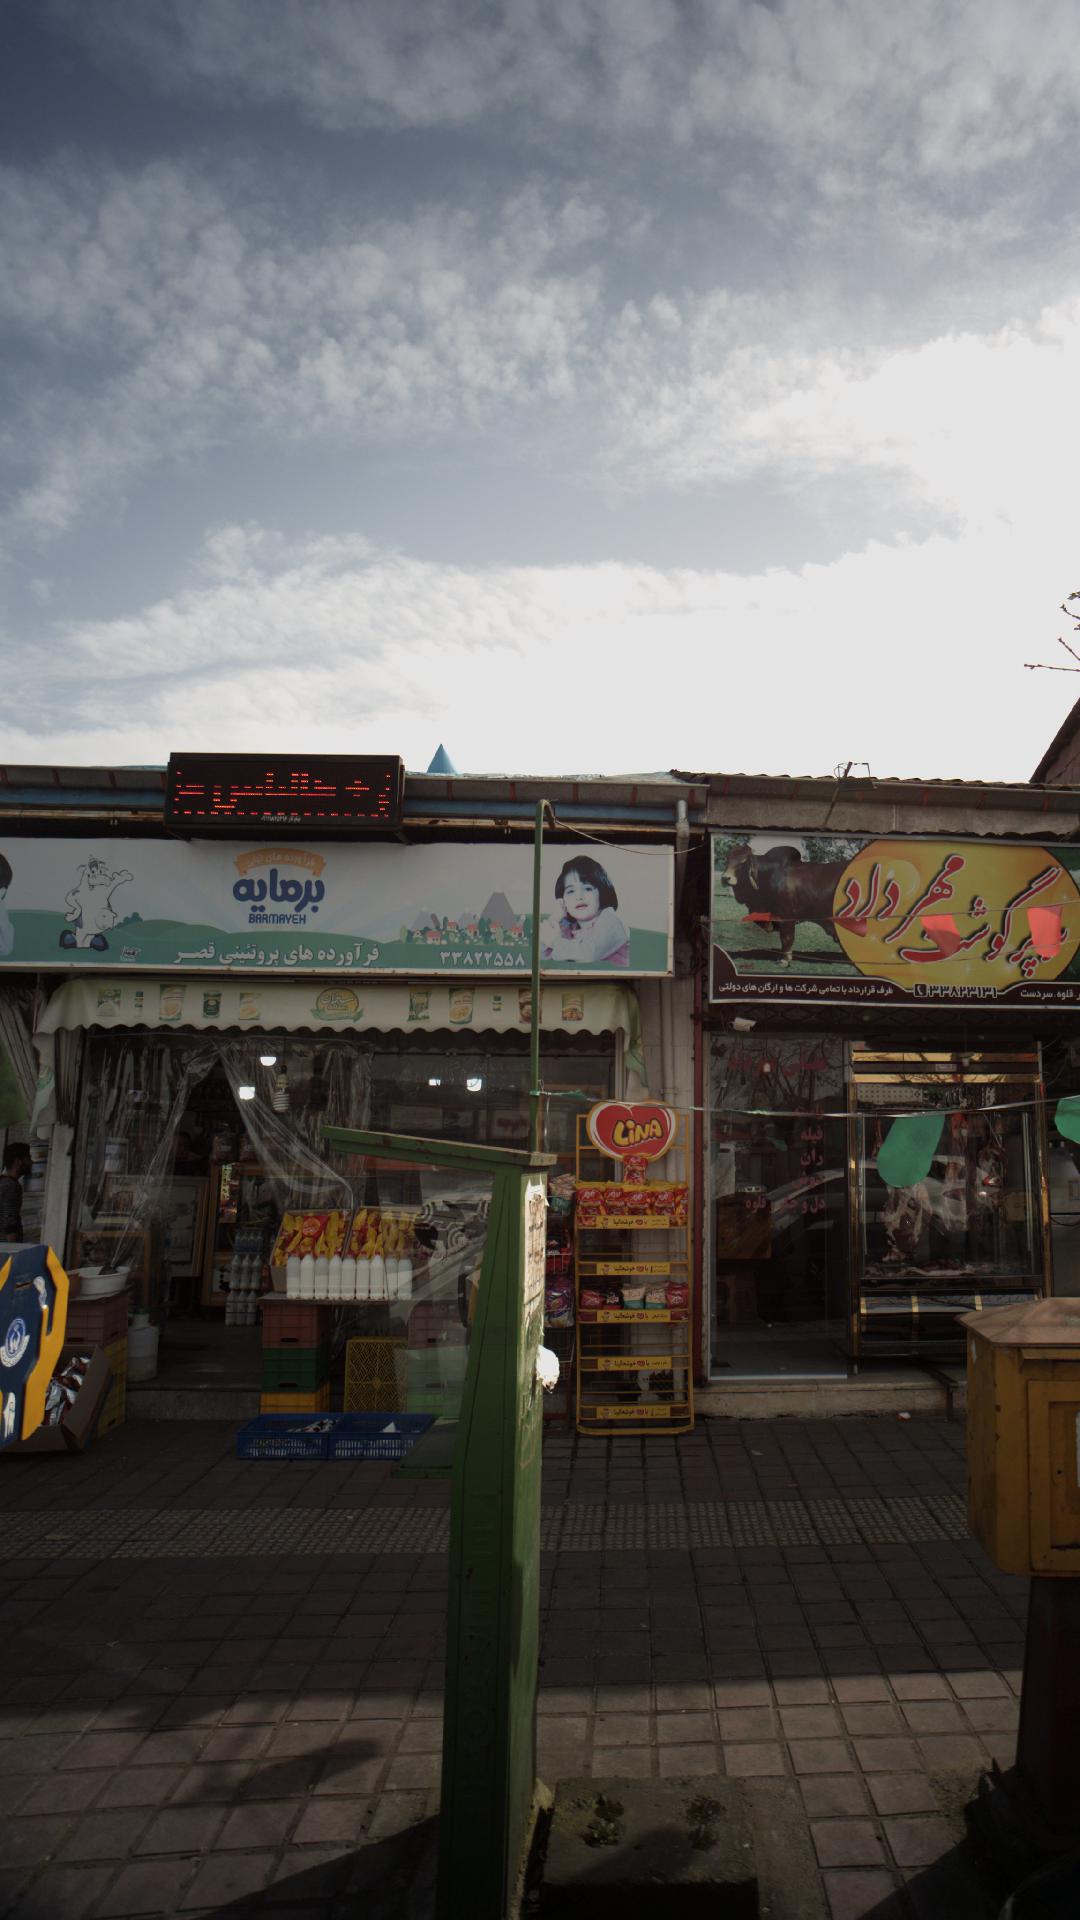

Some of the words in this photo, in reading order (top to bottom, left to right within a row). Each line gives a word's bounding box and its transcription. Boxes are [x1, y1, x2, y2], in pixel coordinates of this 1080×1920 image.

[232, 868, 325, 913] برمایه
[835, 854, 966, 943] مهرداد
[248, 913, 307, 924] BARMAYEH
[173, 941, 216, 964] قصر
[219, 943, 280, 966] پروتئینی
[283, 944, 314, 965] های
[440, 951, 525, 966] ۳۳۸۲۲۵۵۸
[719, 981, 741, 992] دولتی
[742, 981, 757, 992] های
[758, 981, 778, 994] ارگان
[786, 982, 793, 992] ها
[794, 984, 818, 995] شرکت
[819, 985, 841, 995] تمامی
[841, 985, 847, 995] با
[847, 984, 874, 996] قرارداد
[874, 984, 893, 995] طرف
[928, 984, 998, 999] ۳۳۸۲۳۱۳۱
[1020, 988, 1053, 1000] سردست
